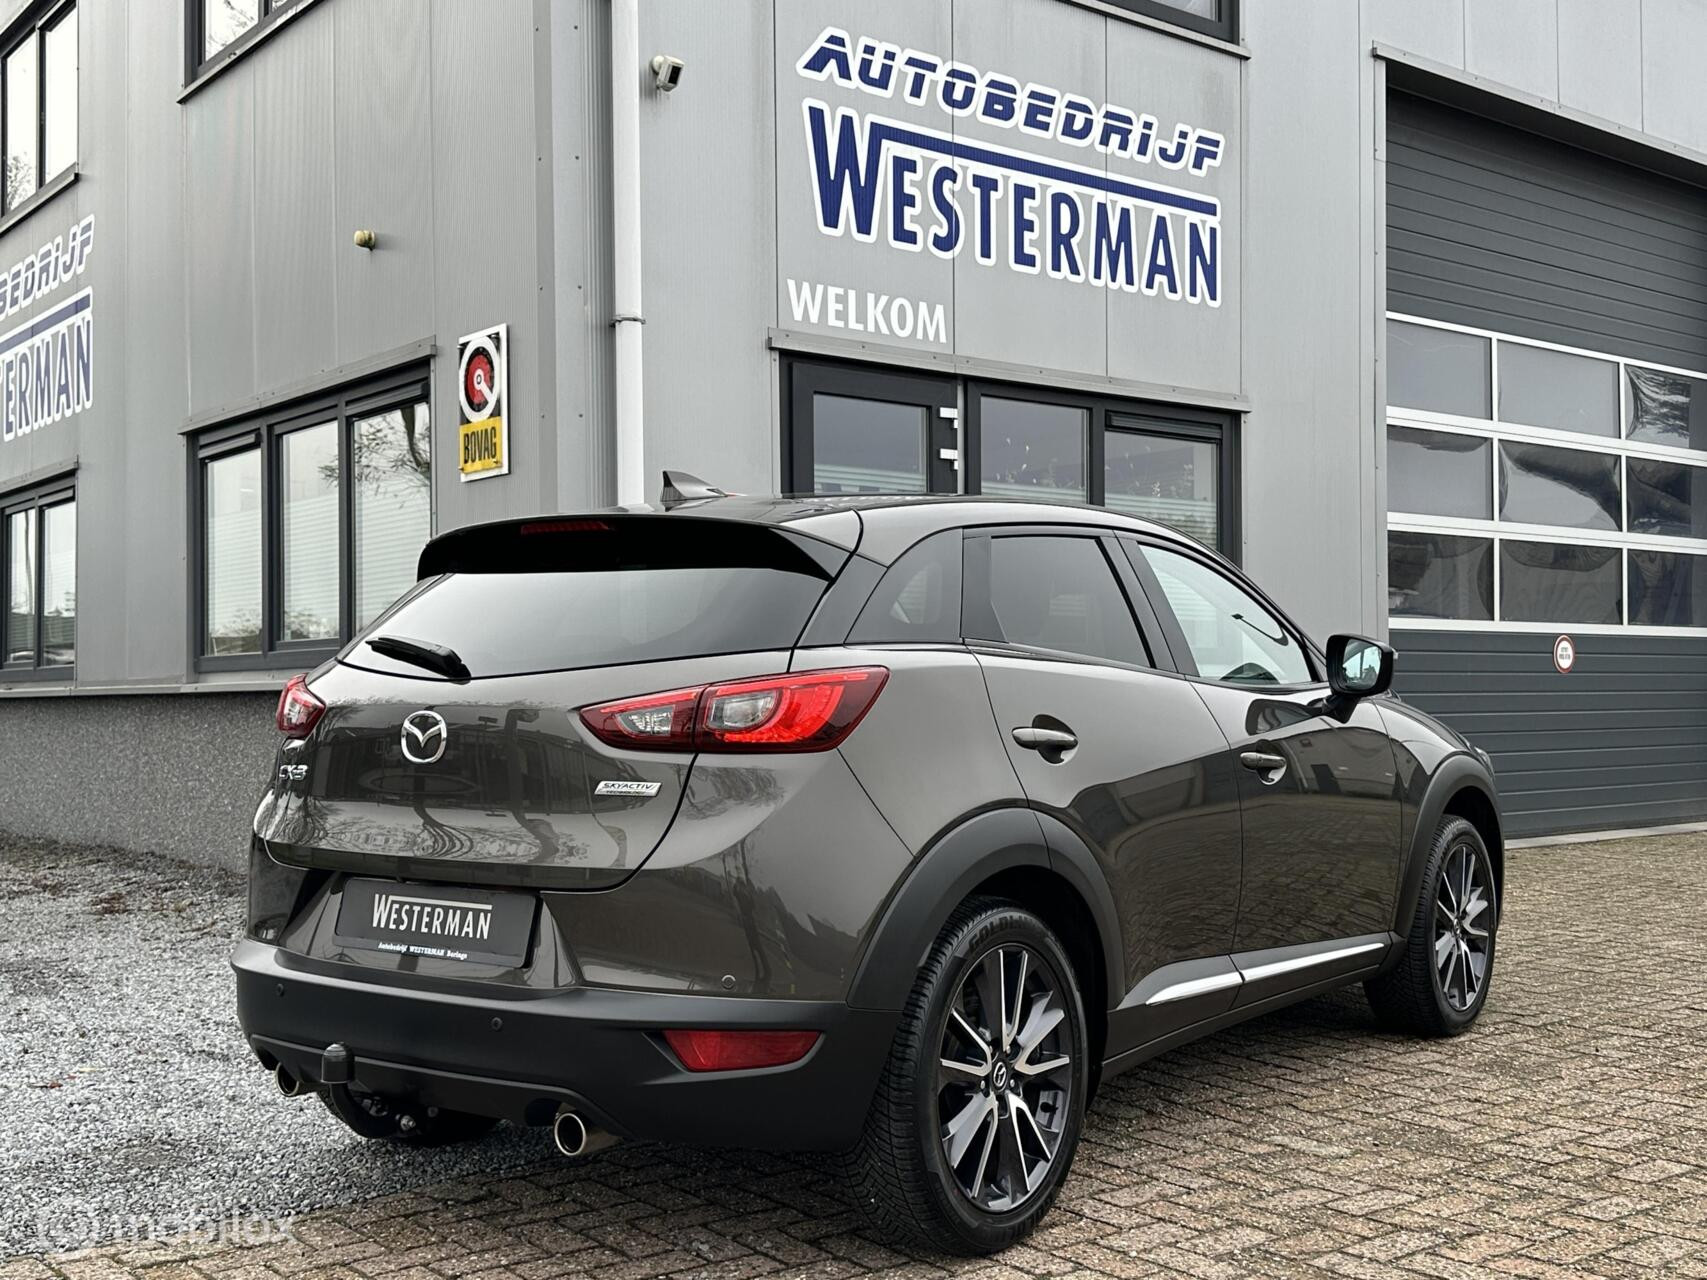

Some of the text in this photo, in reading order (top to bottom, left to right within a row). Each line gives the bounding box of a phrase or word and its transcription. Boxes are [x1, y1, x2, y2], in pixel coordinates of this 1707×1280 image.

[801, 31, 1222, 173] AUTOBEDRIJF
[805, 103, 1219, 303] WESTERMAN
[787, 278, 947, 343] WELKOM
[0, 318, 91, 437] ERMAN
[463, 426, 497, 464] BOVAG
[602, 782, 654, 791] SKYACTIV
[371, 893, 493, 940] WESTERMAN
